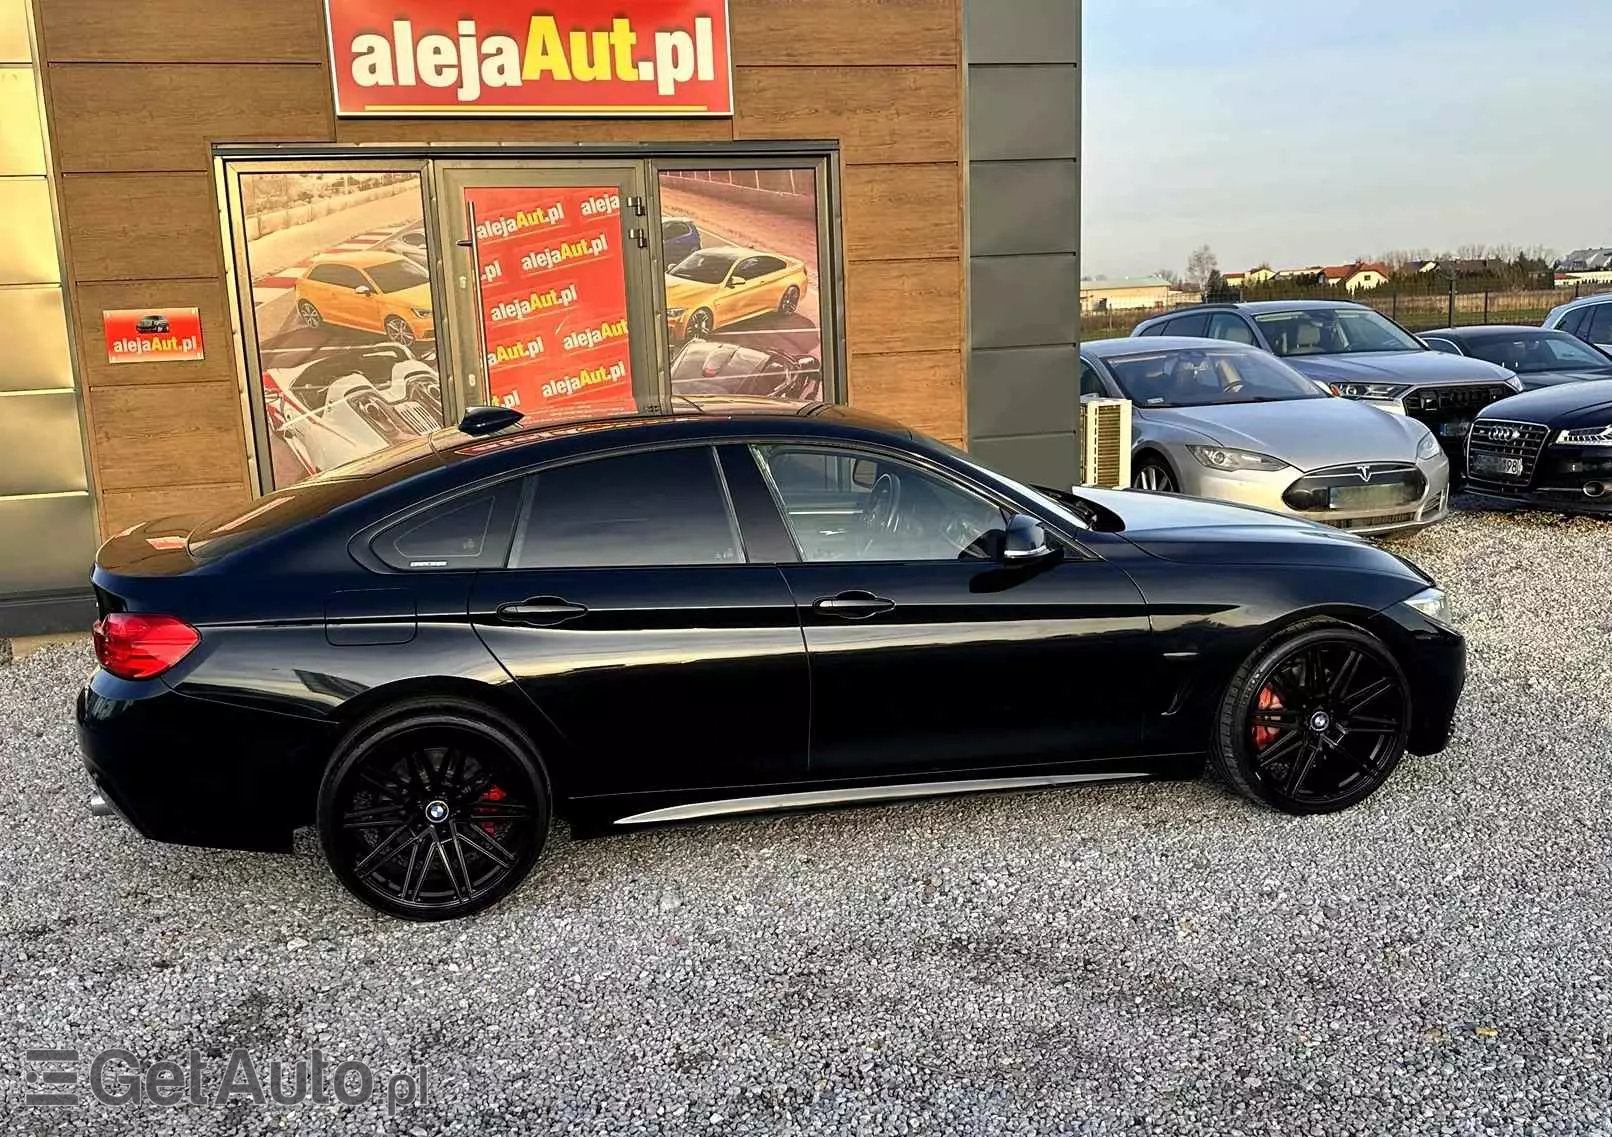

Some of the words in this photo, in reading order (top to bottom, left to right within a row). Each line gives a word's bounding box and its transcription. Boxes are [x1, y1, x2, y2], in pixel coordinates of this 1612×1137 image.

[351, 15, 715, 102] alejaAut.pl
[476, 203, 565, 239] alejaAut.pl
[580, 194, 619, 216] aleja
[520, 234, 608, 271] alejaAut.pl
[490, 285, 577, 322] alejaAut.pl
[112, 336, 197, 354] alejaAut.pl
[563, 319, 628, 350] alejaAut
[541, 361, 626, 398] alejaAut.pl
